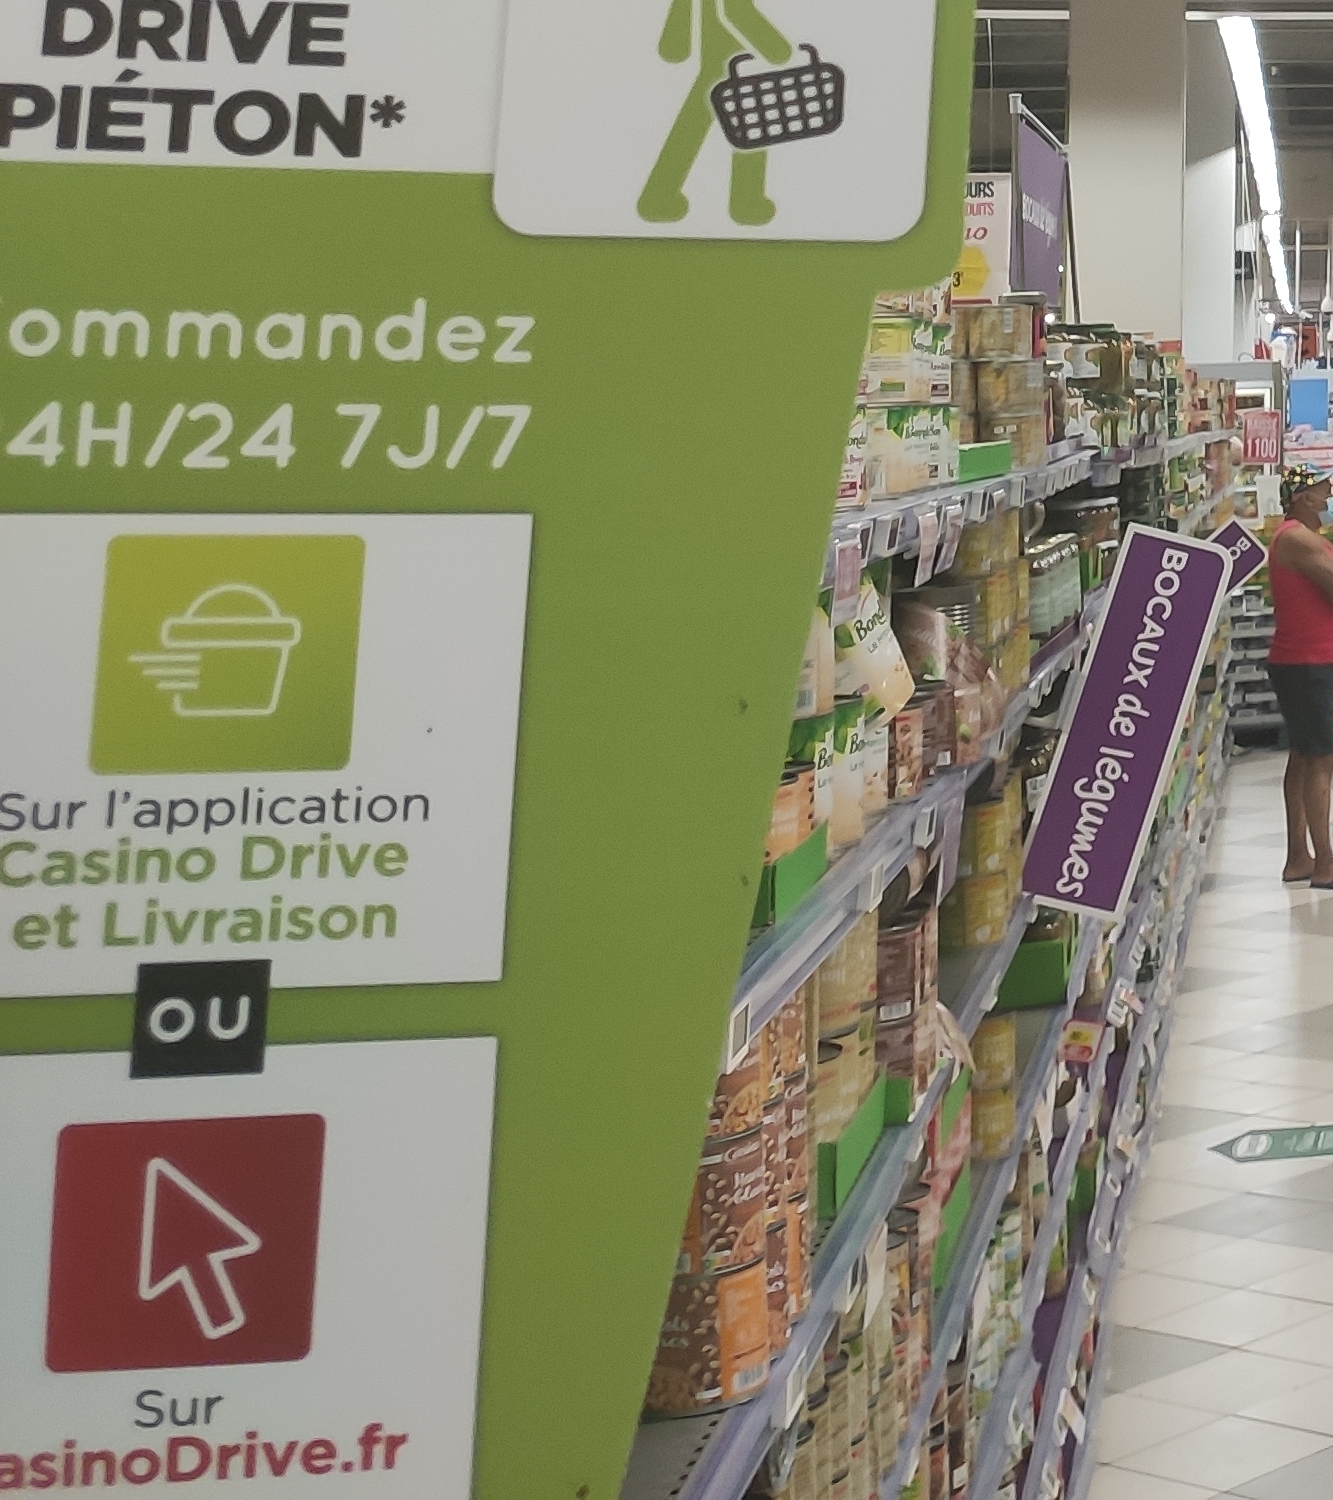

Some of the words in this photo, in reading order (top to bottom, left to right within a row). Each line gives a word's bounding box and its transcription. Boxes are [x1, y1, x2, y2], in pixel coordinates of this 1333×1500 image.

[8, 296, 537, 364] ommandez
[6, 402, 297, 470] 4H/24
[335, 402, 533, 471] 7J/7
[1122, 546, 1189, 690] BOCAUX
[1108, 692, 1150, 738] de
[0, 791, 85, 832] Sur
[104, 785, 432, 836] l'application
[1055, 745, 1136, 898] légumes
[0, 839, 217, 888] Casino
[239, 832, 410, 881] Drive
[11, 902, 81, 951] et
[102, 897, 400, 948] Livraison
[147, 993, 252, 1044] OU
[134, 1387, 224, 1431] Sur
[0, 1423, 409, 1490] asinoDrive.fr
